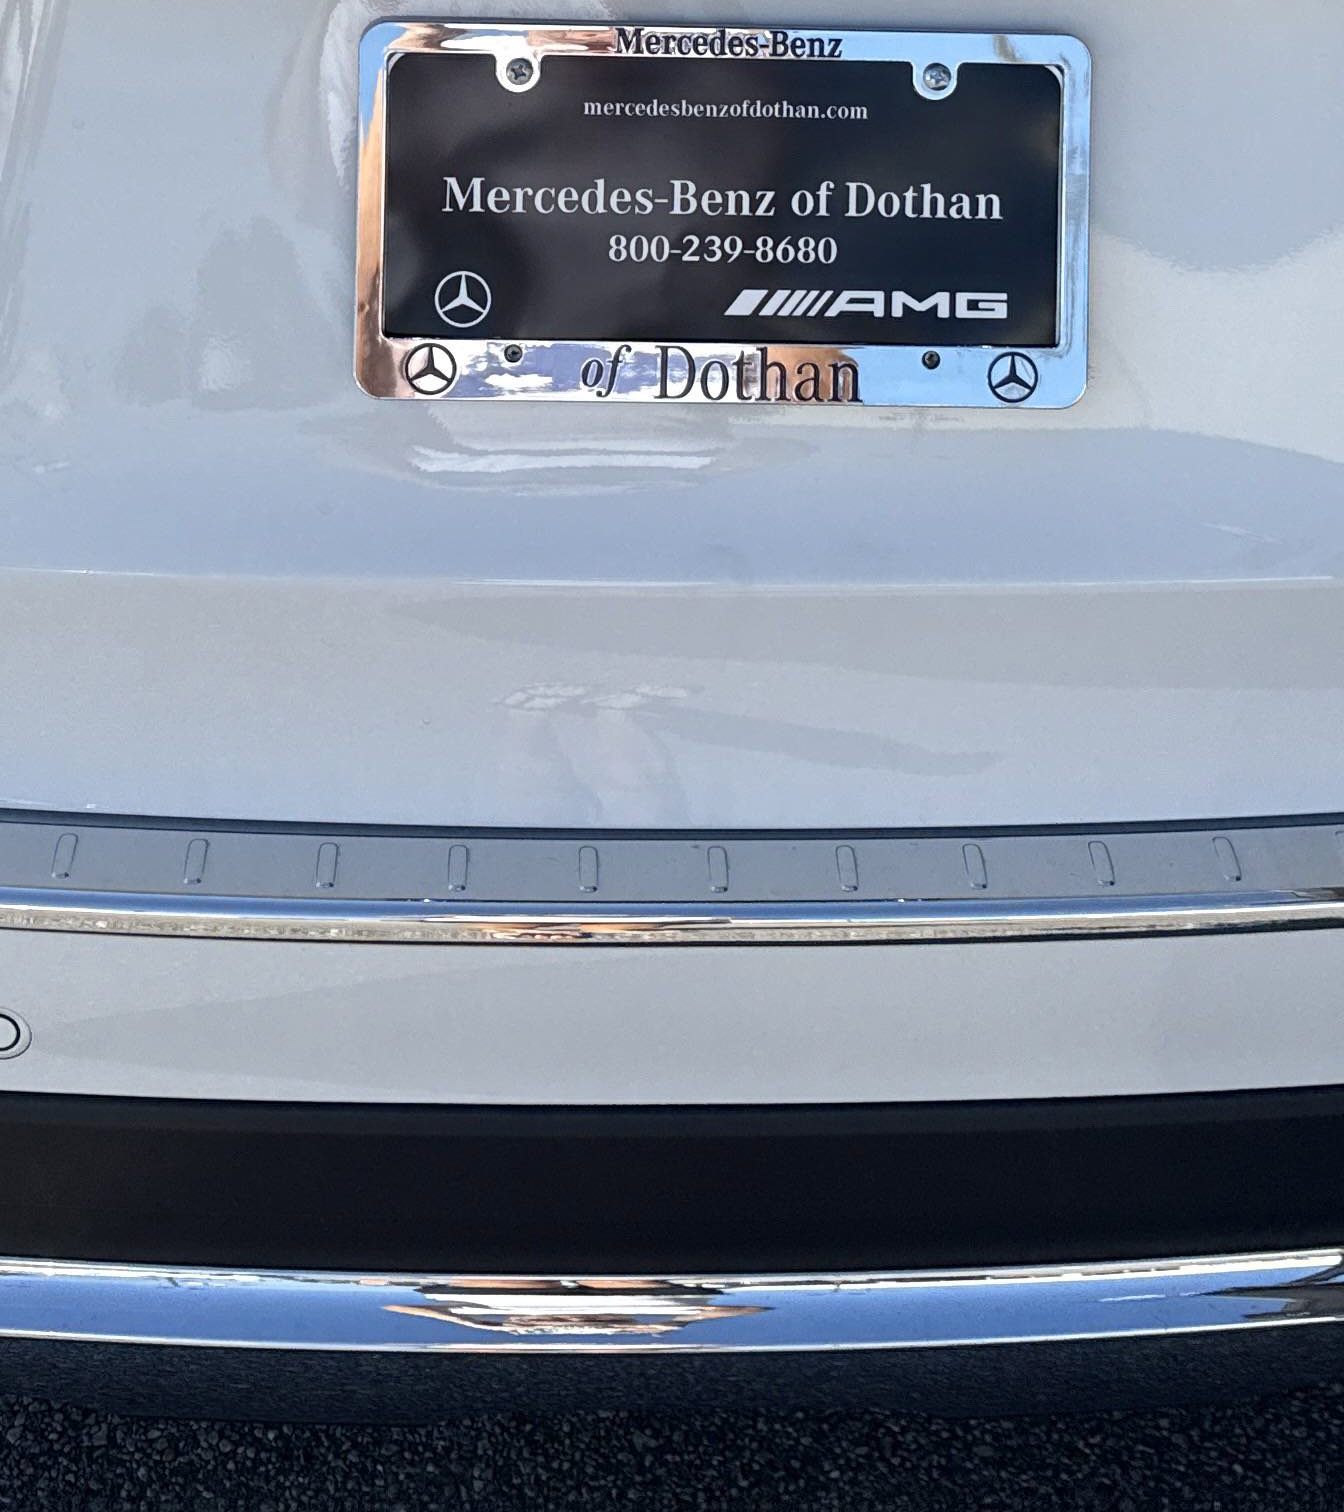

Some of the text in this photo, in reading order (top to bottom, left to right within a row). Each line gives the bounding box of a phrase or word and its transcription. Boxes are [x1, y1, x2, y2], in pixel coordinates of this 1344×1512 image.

[614, 27, 843, 60] Mercedes-Benz
[582, 97, 868, 122] mercedesbenzofdothan.com
[442, 175, 1004, 221] Mercedes-Benz of Dothan
[607, 234, 838, 265] 800-239-8680
[831, 290, 1009, 319] AMG
[580, 344, 863, 403] of Dothan
